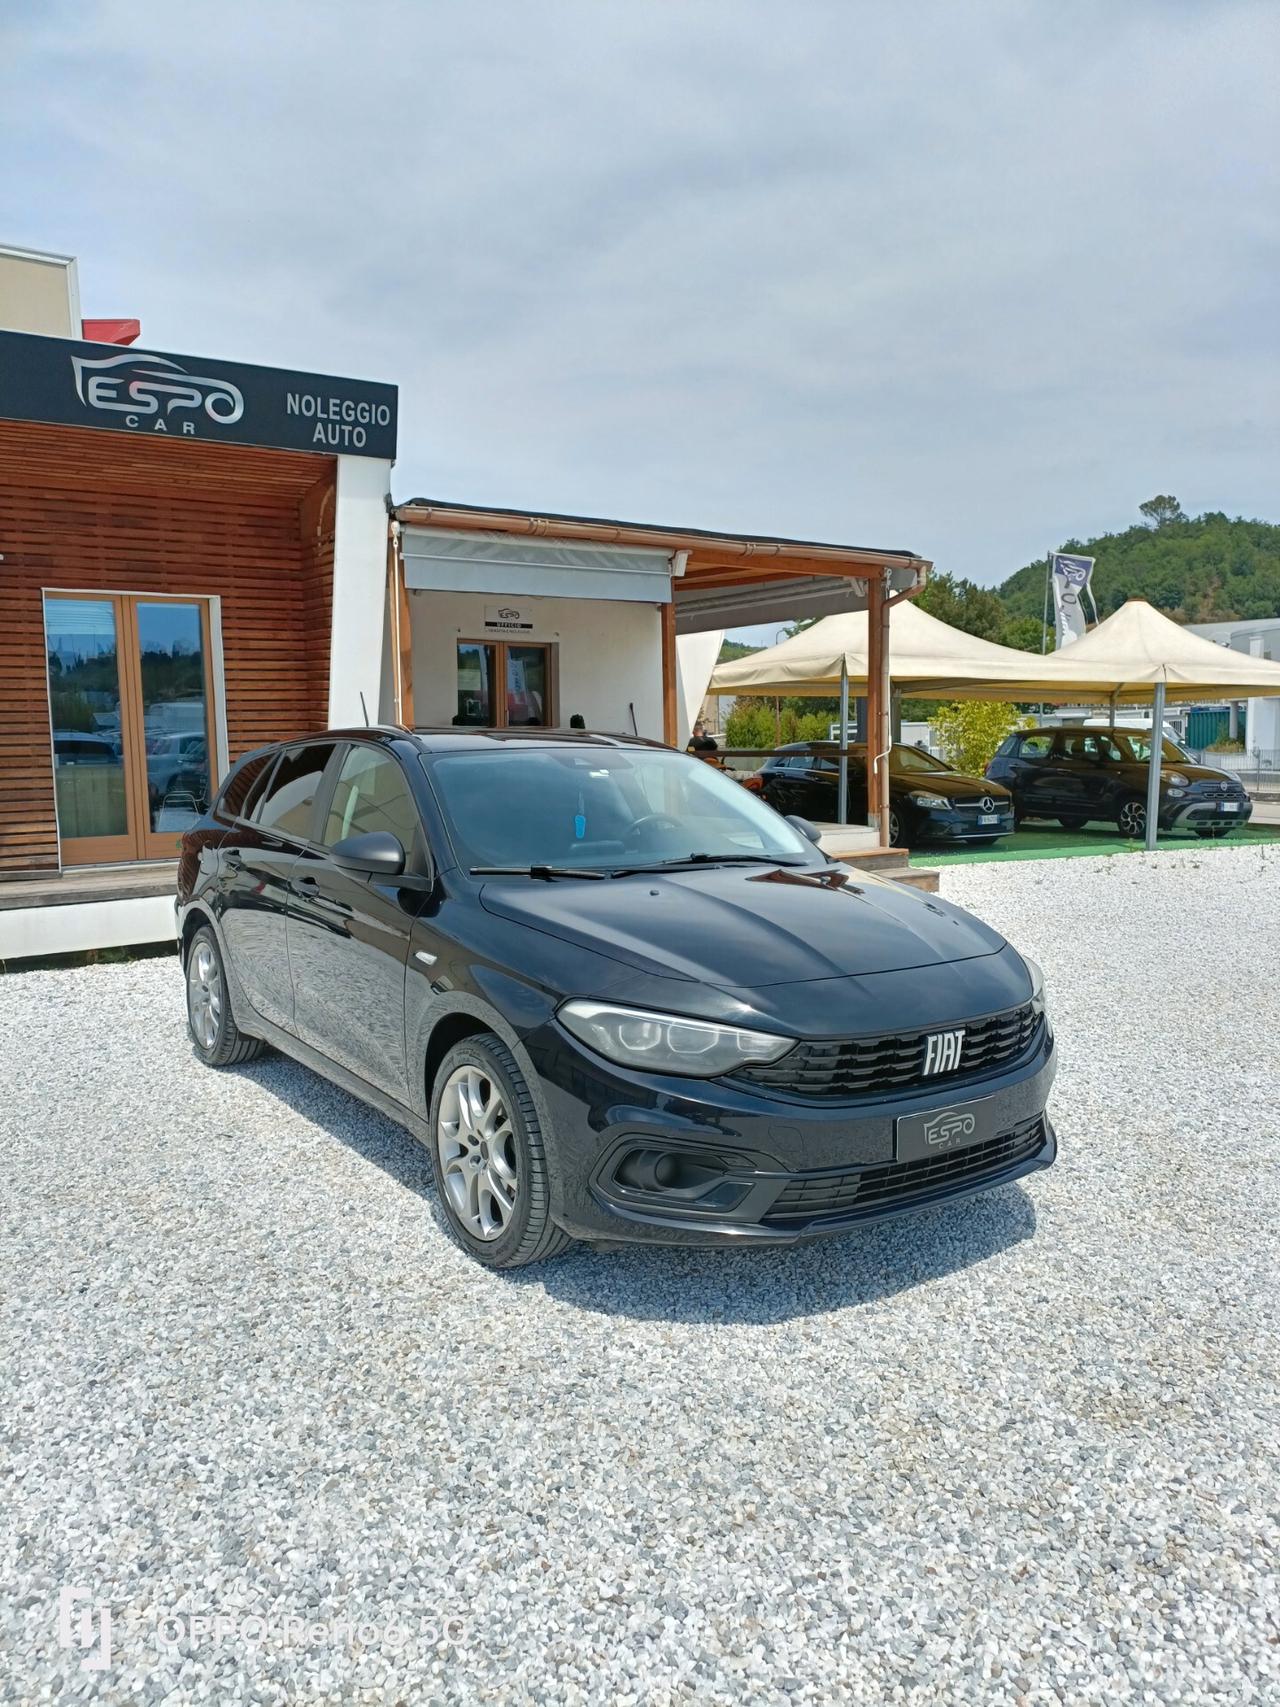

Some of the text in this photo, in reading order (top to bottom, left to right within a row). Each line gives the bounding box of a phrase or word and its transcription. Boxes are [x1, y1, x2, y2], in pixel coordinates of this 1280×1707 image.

[87, 370, 245, 425] ESPO
[286, 392, 391, 427] NOLEGGIO
[125, 414, 196, 435] CAR
[312, 422, 367, 448] AUTO
[922, 1029, 966, 1076] FIAT
[928, 1113, 976, 1145] ESPO
[938, 1137, 961, 1149] CAR
